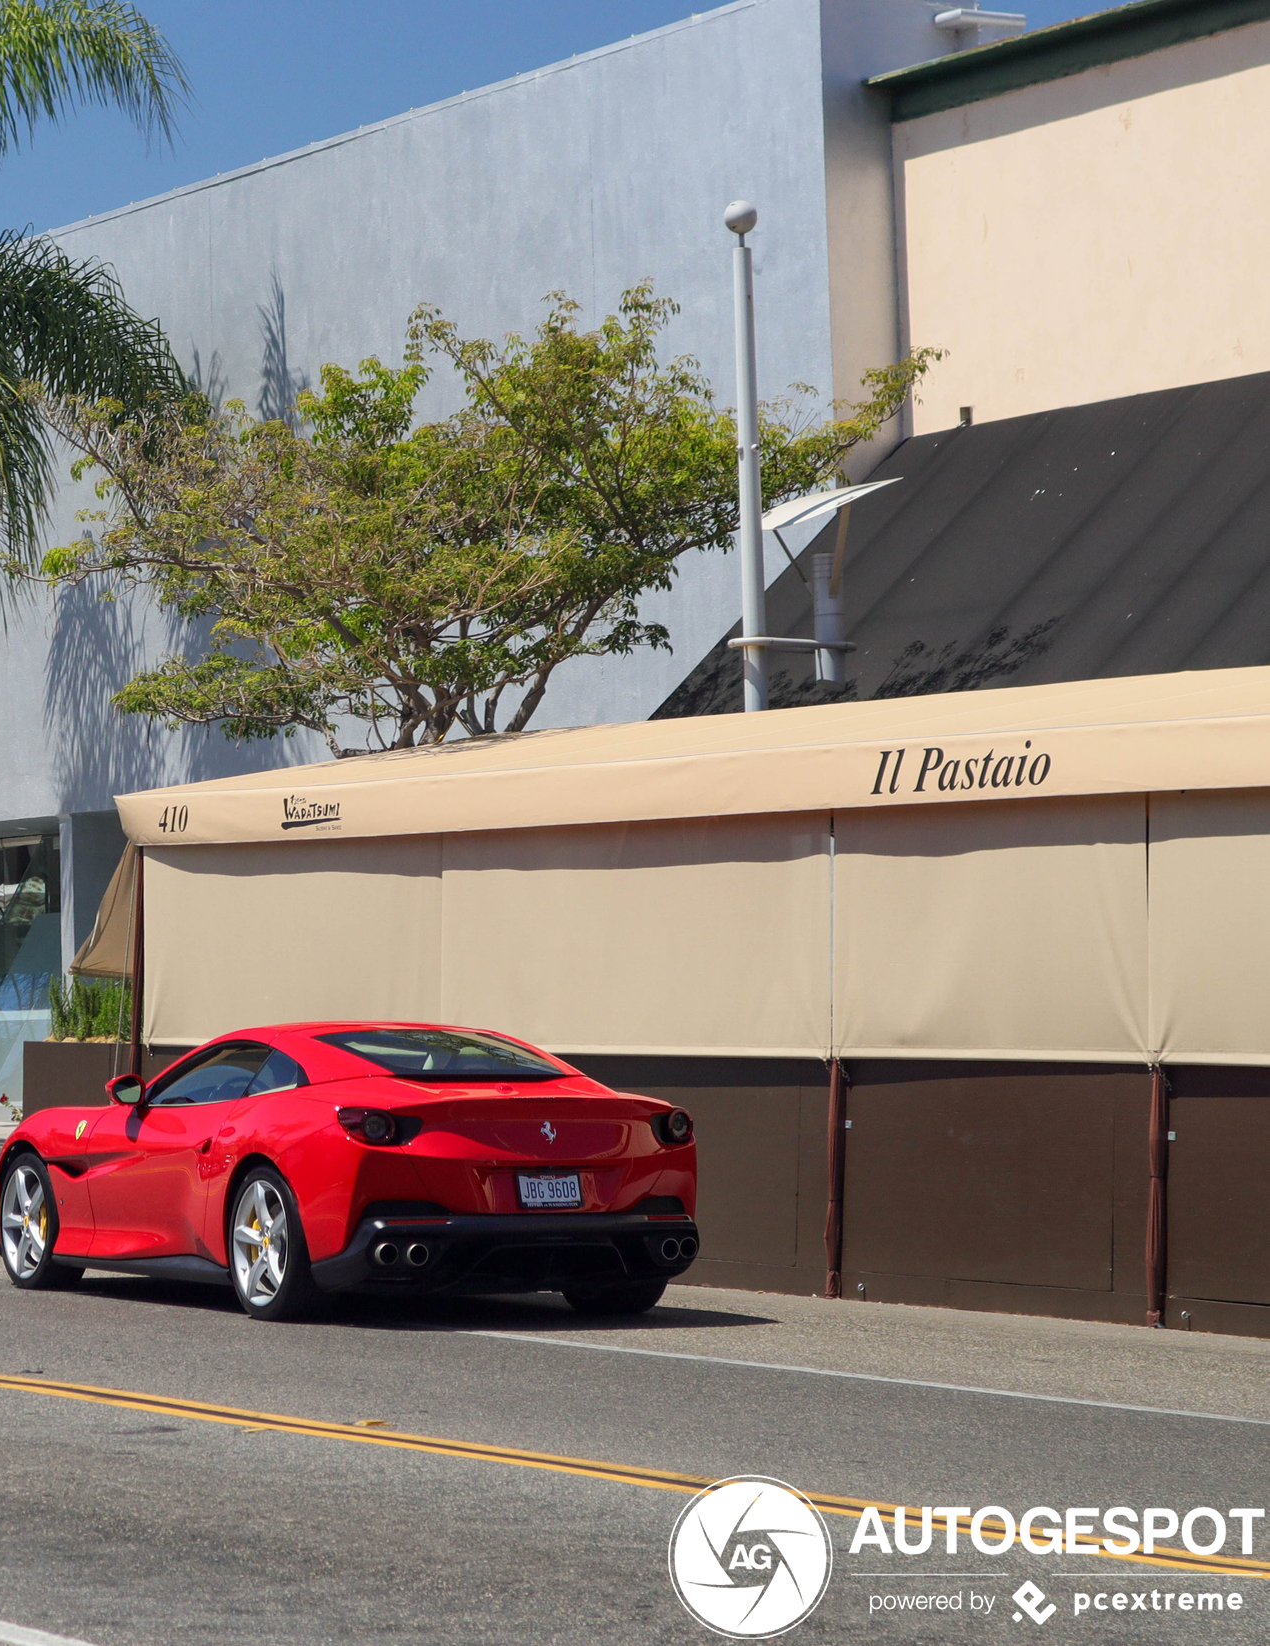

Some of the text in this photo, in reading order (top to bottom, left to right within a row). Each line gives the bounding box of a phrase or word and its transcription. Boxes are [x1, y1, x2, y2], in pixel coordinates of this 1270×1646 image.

[870, 740, 1052, 795] Il Pastaio
[158, 804, 189, 834] 410
[283, 798, 340, 821] WADATSUMI
[524, 1181, 577, 1199] JBG 9608
